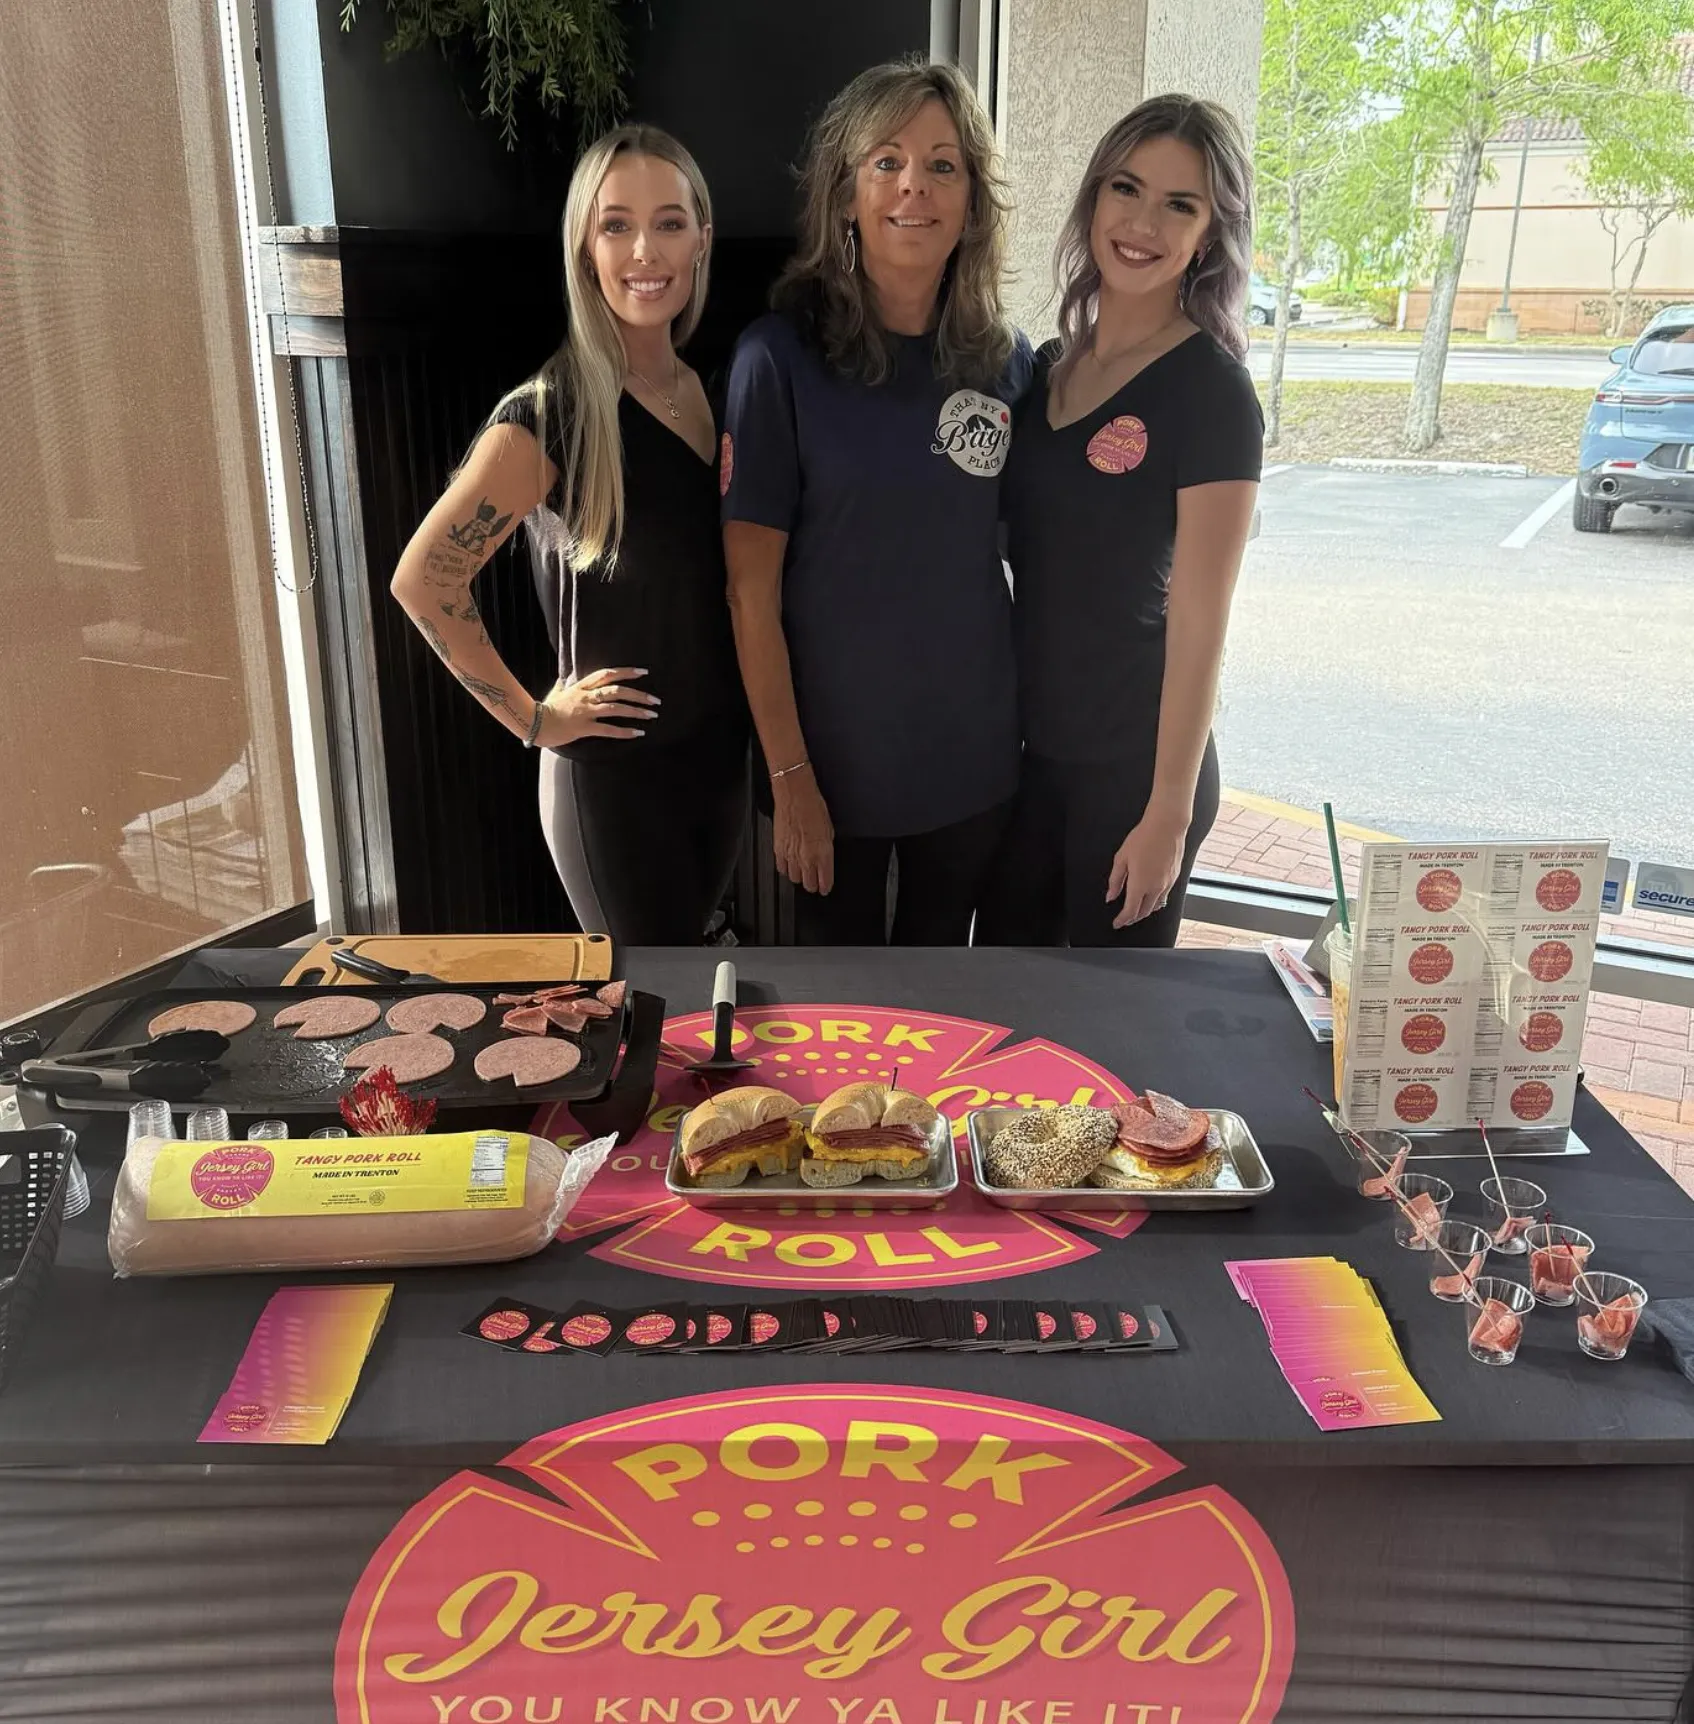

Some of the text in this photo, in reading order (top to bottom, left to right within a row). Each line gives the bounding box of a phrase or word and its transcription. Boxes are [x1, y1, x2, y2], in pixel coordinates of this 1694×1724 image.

[949, 396, 977, 418] THAT
[931, 419, 1010, 458] Bage
[1094, 456, 1119, 470] ROLL
[1408, 852, 1433, 860] TANGY
[1580, 851, 1599, 859] ROLL
[1401, 926, 1426, 934] TANGY
[1451, 925, 1471, 933] ROLL
[1521, 924, 1546, 932] TANGY
[221, 1147, 257, 1155] PORK
[295, 1152, 423, 1165] TANGY PORK ROLL
[610, 1155, 668, 1172] OU
[195, 1160, 271, 1176] Jersey Girl
[312, 1169, 400, 1179] MADE IN TRENTON
[211, 1193, 245, 1205] ROLL
[687, 1222, 1003, 1267] ROLL
[612, 1420, 1073, 1505] PORK
[384, 1570, 1238, 1683] Jersey Girl
[430, 1696, 564, 1724] YOU
[594, 1697, 801, 1724] KNOW
[827, 1698, 901, 1724] YA
[933, 1699, 1074, 1724] LIKE
